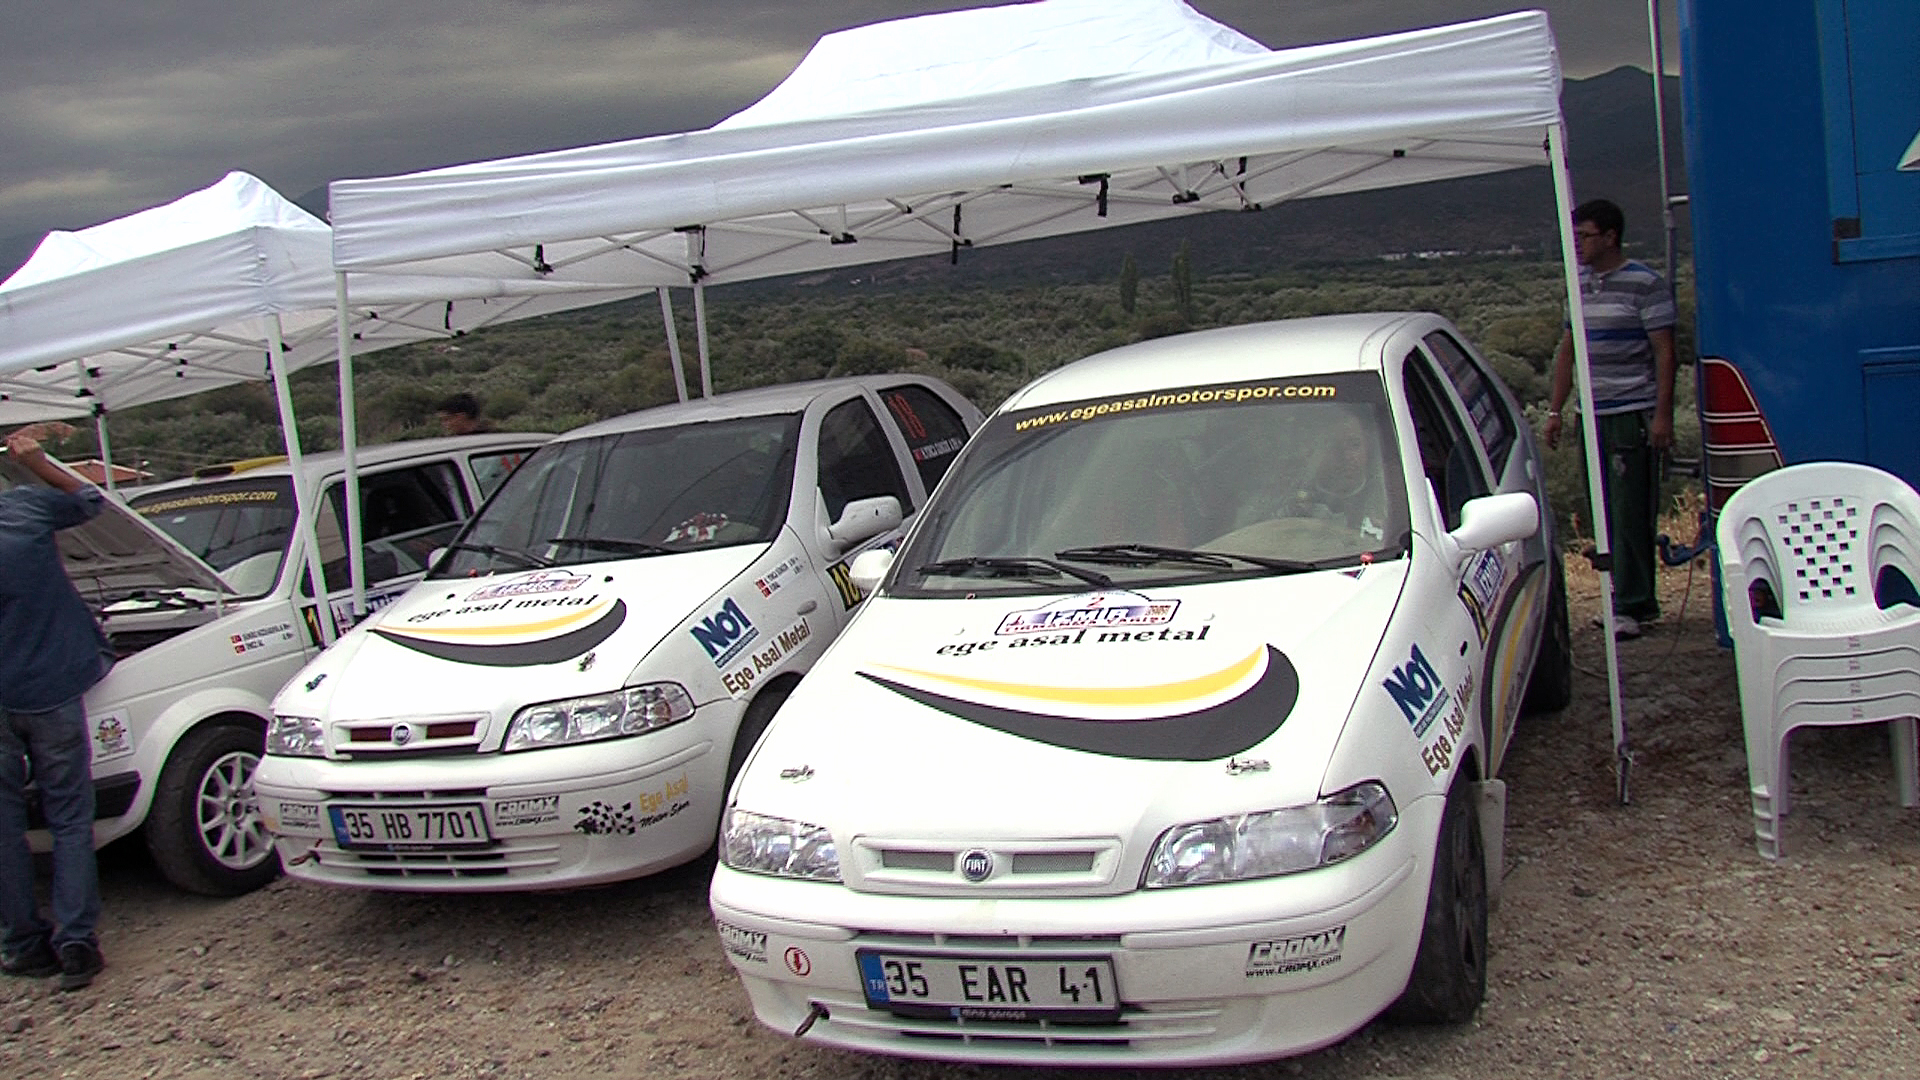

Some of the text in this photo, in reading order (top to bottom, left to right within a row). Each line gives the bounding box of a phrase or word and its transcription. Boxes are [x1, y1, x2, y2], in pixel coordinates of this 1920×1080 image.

[1015, 384, 1336, 430] www.egeasalmotorspor.com
[407, 594, 599, 622] ege asal metal
[722, 671, 756, 695] Ege
[752, 641, 783, 674] Asal
[779, 617, 811, 648] Metal
[936, 624, 1210, 656] ege asal metal
[1421, 735, 1452, 777] Ege
[1444, 696, 1466, 744] Asal
[495, 796, 559, 817] CROMX
[346, 811, 481, 839] 35 HB 7701
[965, 859, 987, 873] FIAT
[1247, 925, 1346, 964] CROMX
[885, 961, 1104, 1002] 35 EAR 41
